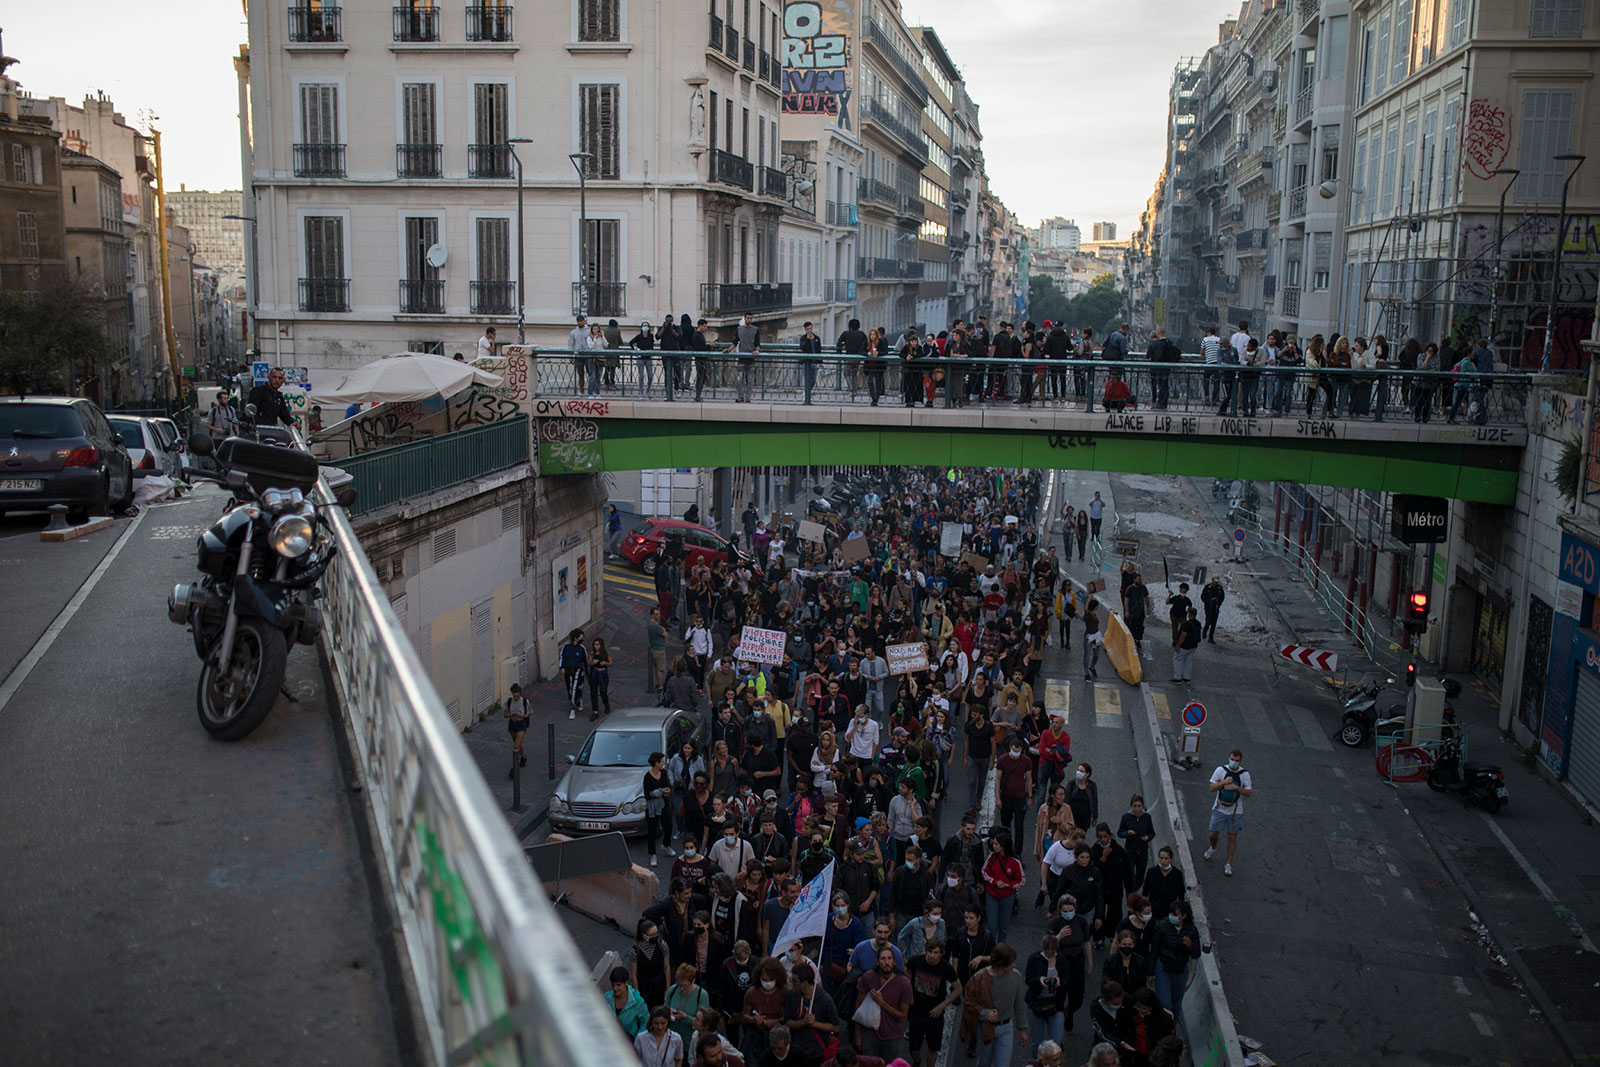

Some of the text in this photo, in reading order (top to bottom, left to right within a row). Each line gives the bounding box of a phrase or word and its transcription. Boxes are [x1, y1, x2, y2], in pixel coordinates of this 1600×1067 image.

[537, 400, 566, 417] OM
[1106, 415, 1143, 431] ALSACE
[1297, 420, 1336, 438] STEAK
[1407, 511, 1445, 527] Métro
[1563, 543, 1595, 585] A2D
[744, 627, 785, 641] VIOLENCE
